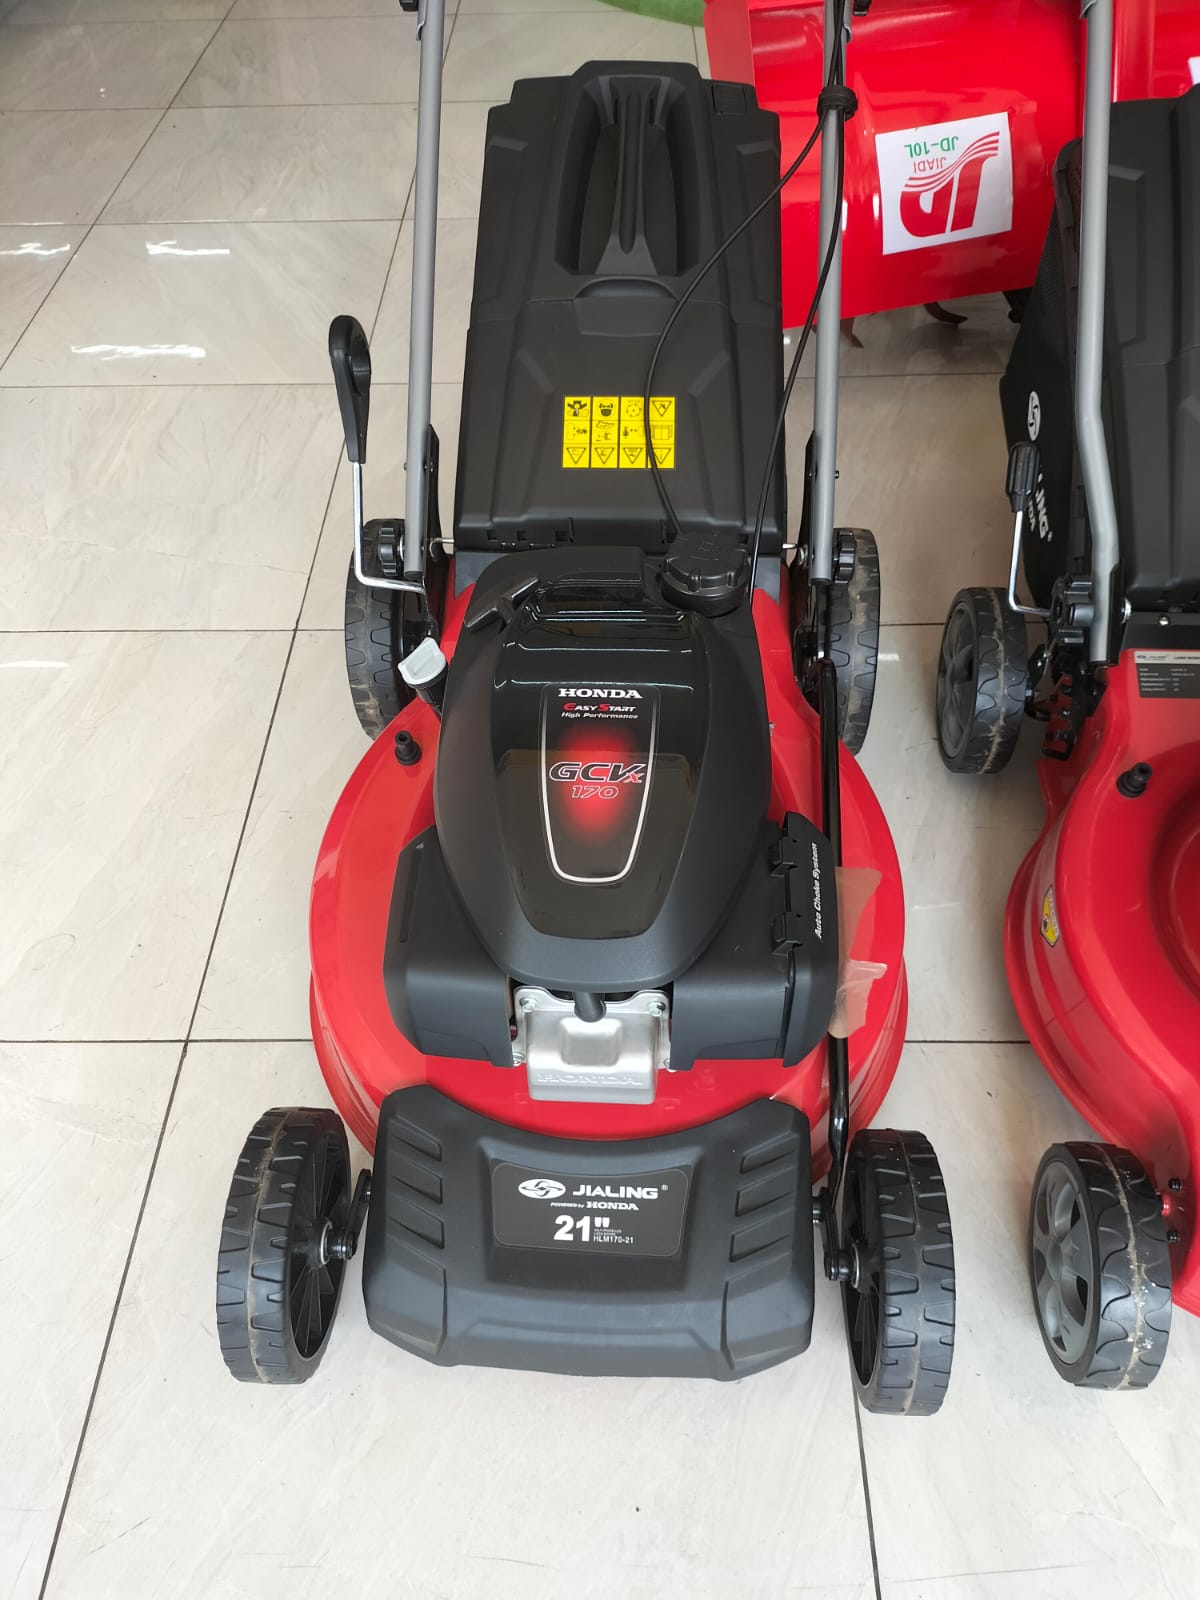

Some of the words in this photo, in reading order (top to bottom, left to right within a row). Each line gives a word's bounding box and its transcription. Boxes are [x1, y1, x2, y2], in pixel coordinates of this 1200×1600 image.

[904, 136, 959, 158] JD-10L
[913, 157, 946, 173] JIADI
[558, 688, 643, 699] HONDA
[563, 702, 598, 711] EASY
[598, 703, 637, 712] START
[571, 785, 619, 799] 170
[812, 842, 821, 879] System
[813, 879, 821, 912] Choke
[814, 912, 822, 940] Auto
[572, 1184, 659, 1200] JIALING
[586, 1201, 640, 1211] HONDA
[593, 1235, 634, 1244] HLM170-21
